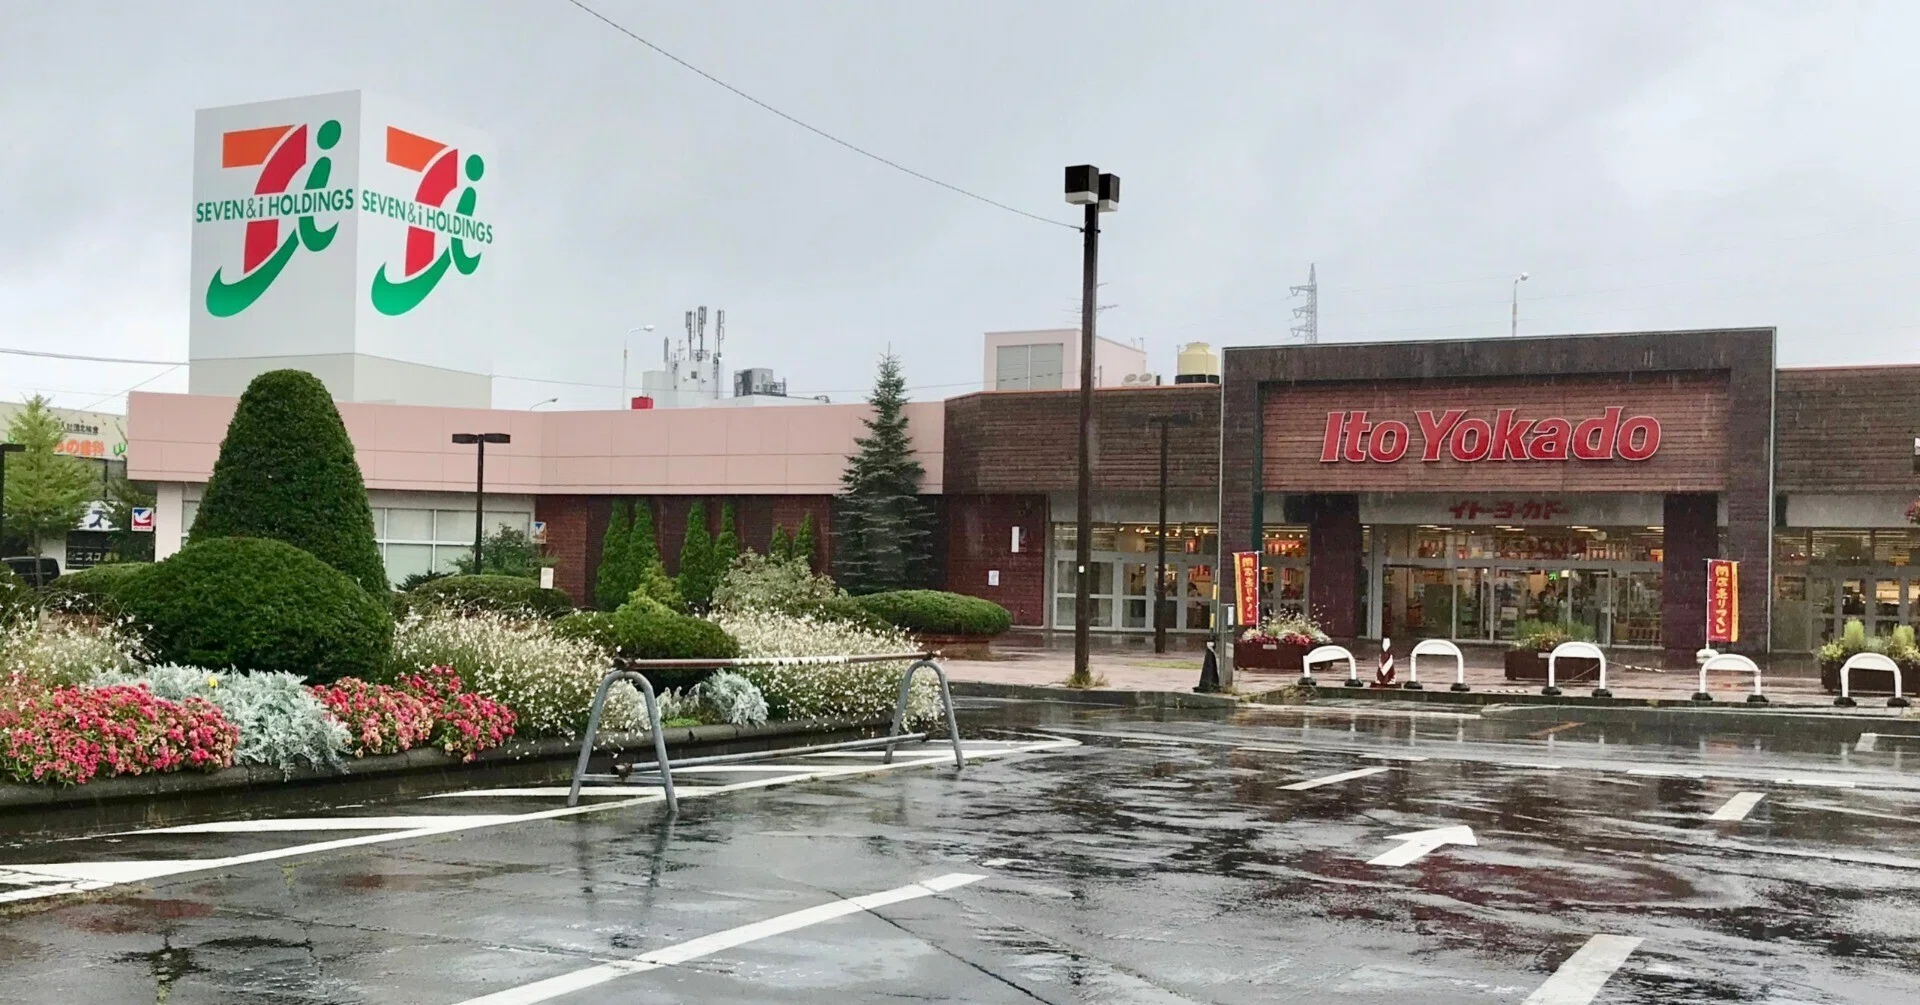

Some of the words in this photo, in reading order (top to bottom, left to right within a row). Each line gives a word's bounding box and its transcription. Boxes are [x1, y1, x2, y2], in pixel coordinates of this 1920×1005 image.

[269, 188, 354, 216] HOLDINGS
[427, 212, 493, 244] HOLDINGS
[1320, 410, 1409, 463] Ito
[1413, 406, 1662, 463] Yokado
[1448, 500, 1569, 520] イトーヨーカドー
